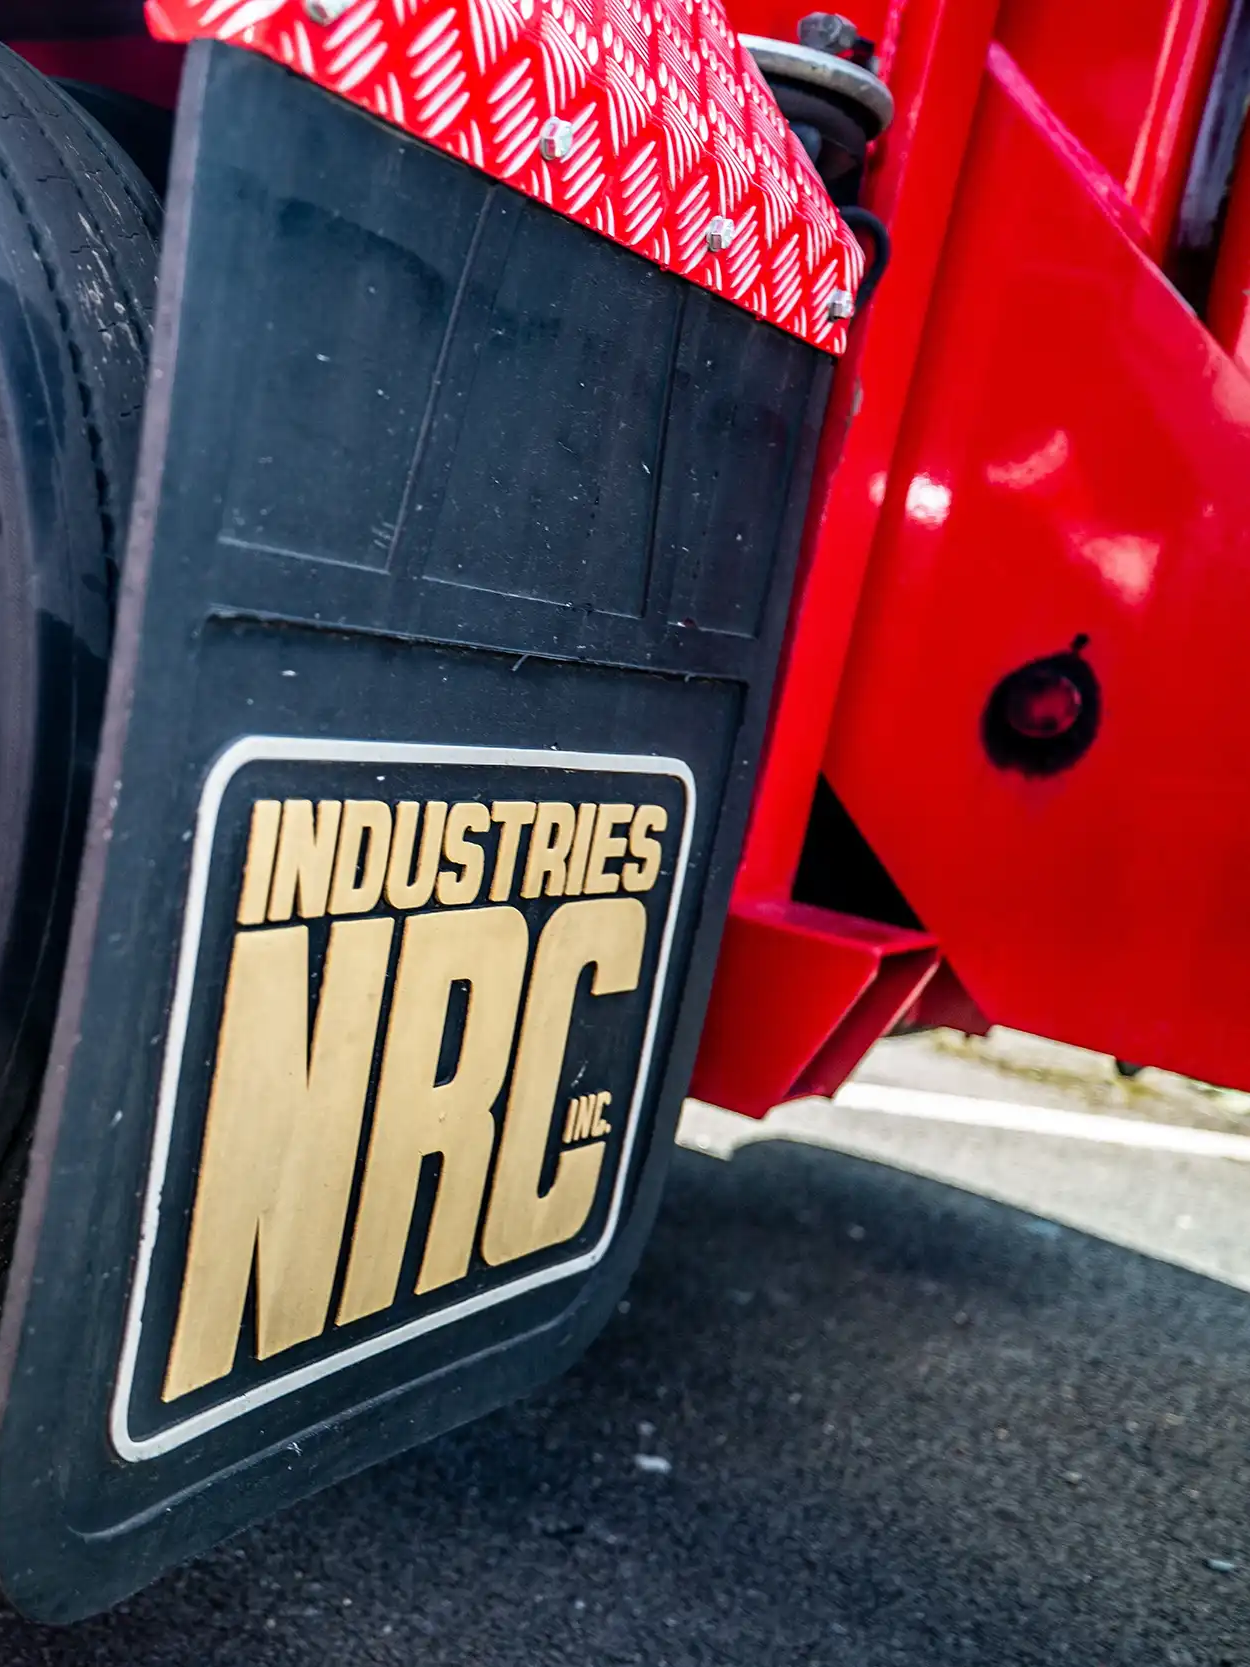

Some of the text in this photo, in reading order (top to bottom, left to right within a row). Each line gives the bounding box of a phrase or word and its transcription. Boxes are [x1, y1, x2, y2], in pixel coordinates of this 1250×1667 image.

[237, 799, 668, 925] INDUSTRIES
[161, 897, 647, 1403] NRC
[561, 1091, 612, 1143] INC.
